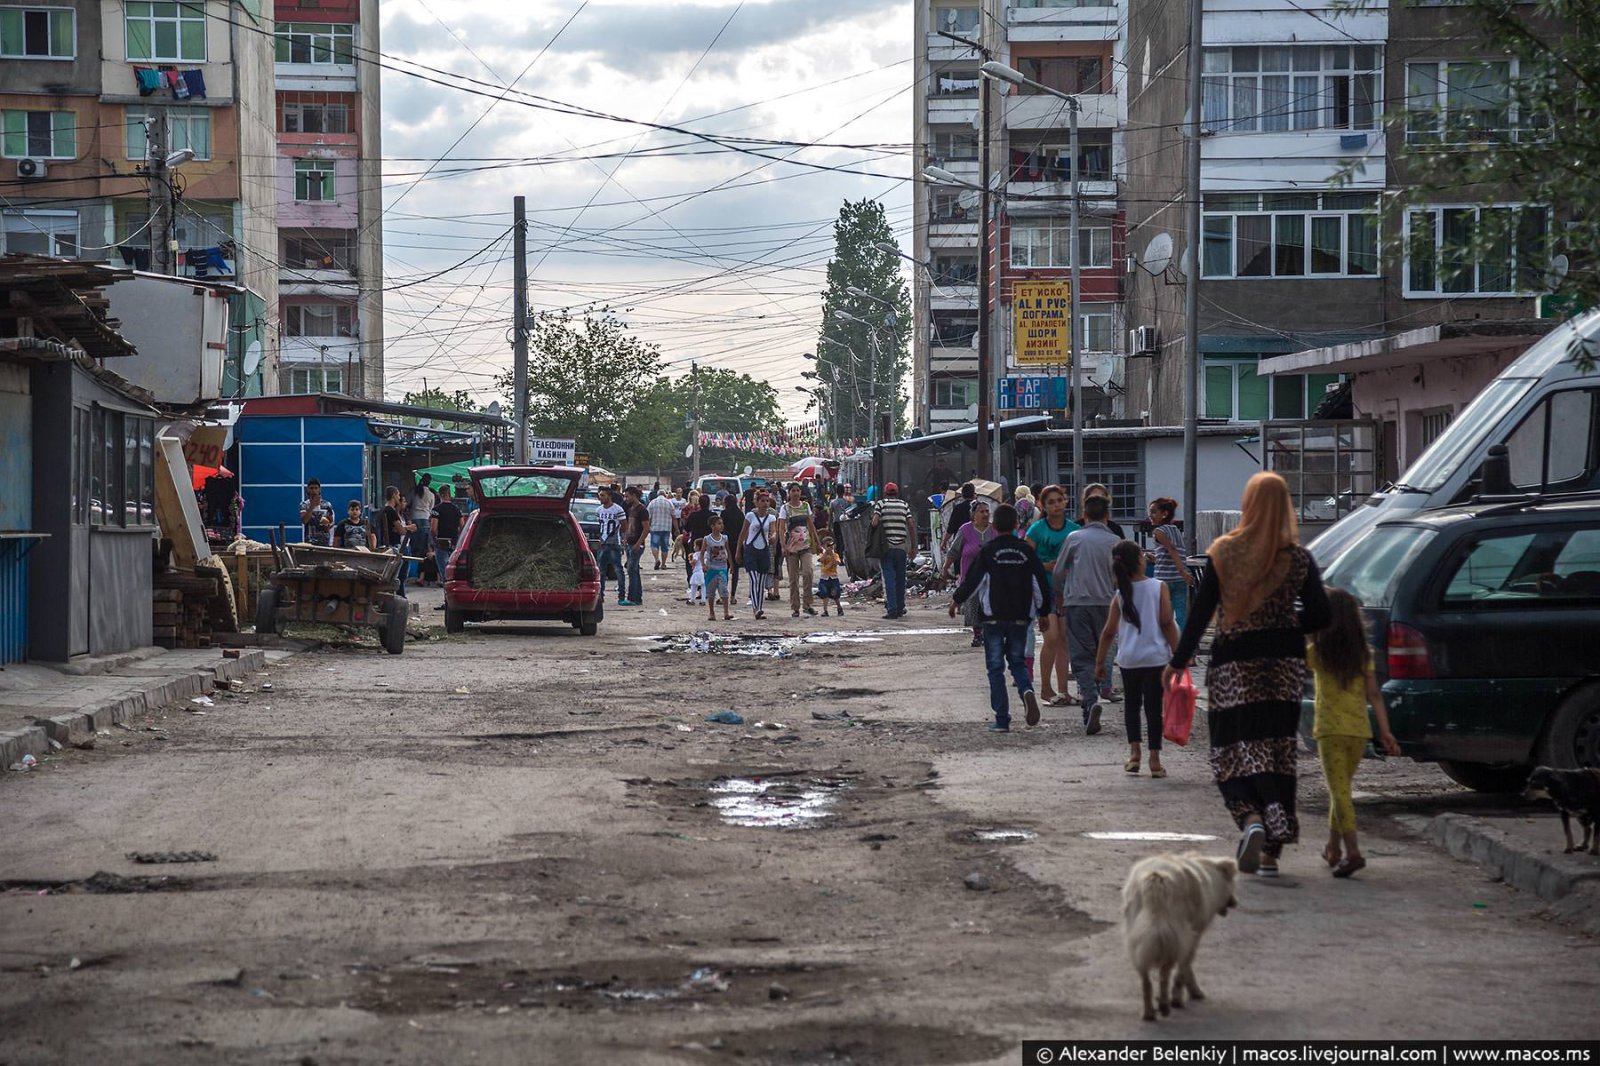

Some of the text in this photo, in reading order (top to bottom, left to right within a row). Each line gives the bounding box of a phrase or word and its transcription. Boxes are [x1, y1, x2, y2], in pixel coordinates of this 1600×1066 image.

[1047, 298, 1066, 309] PVC
[1022, 310, 1064, 319] ДОГРАМА
[1031, 319, 1066, 328] ПАРАПЕТИ
[530, 440, 575, 450] ТЕЛЕФОННИ
[537, 450, 567, 460] КАБИНИ
